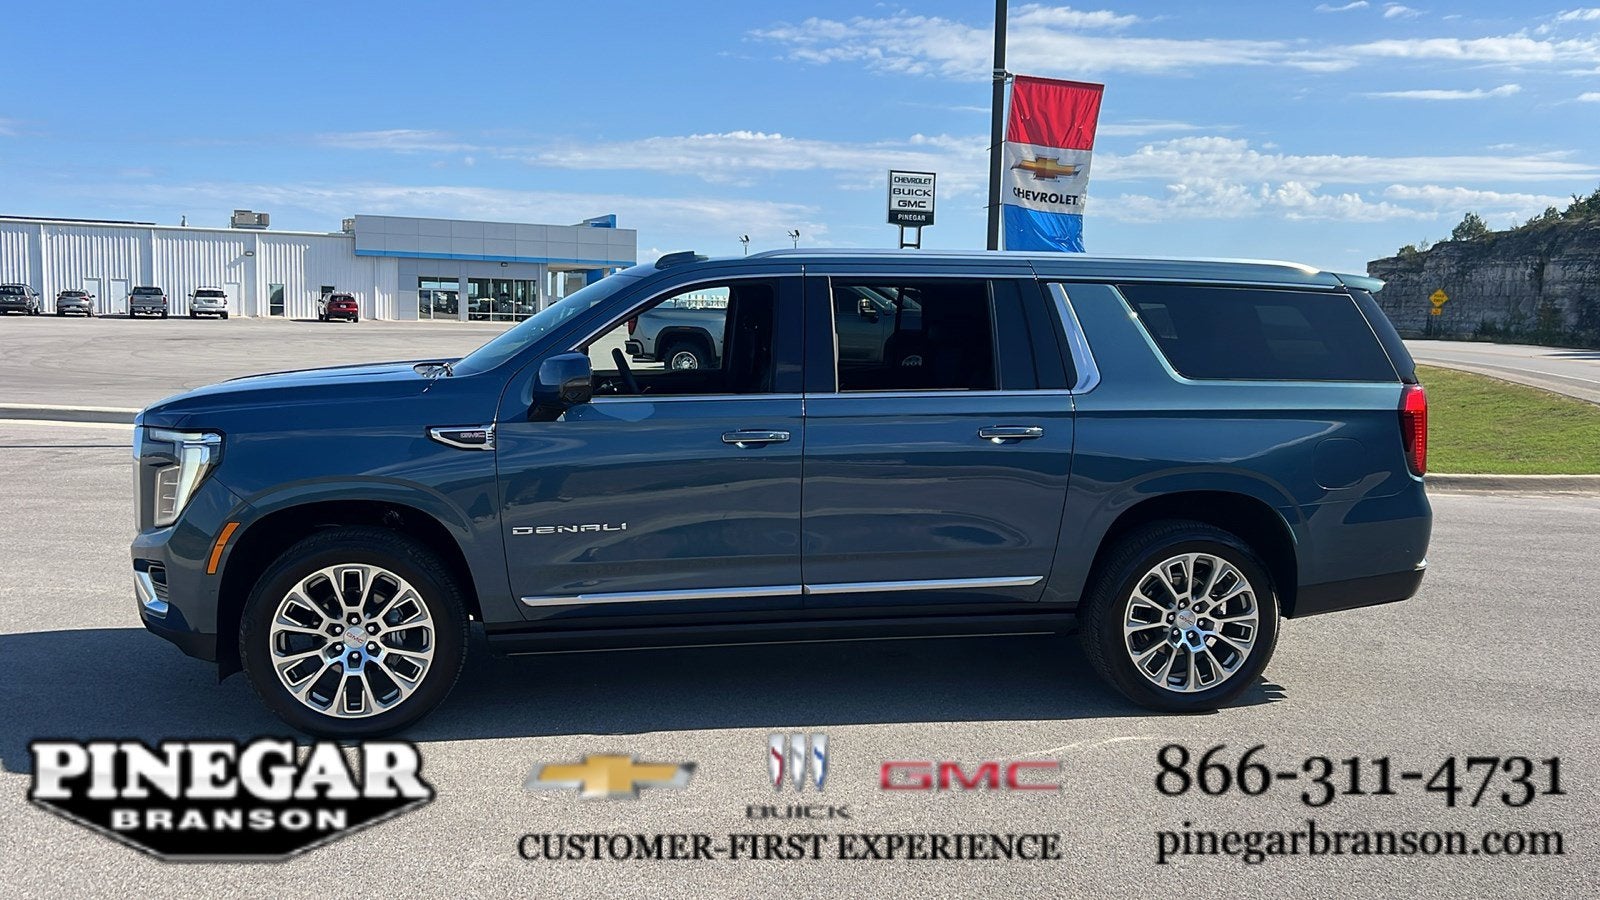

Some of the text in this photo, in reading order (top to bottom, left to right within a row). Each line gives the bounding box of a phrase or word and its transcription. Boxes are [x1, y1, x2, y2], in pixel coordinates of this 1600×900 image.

[894, 176, 932, 185] CHEVROLET
[893, 187, 931, 197] BUICK
[1013, 187, 1078, 205] CHEVROLET
[897, 200, 926, 208] GMC
[897, 213, 926, 221] PINEGAR
[512, 522, 627, 535] DENALI
